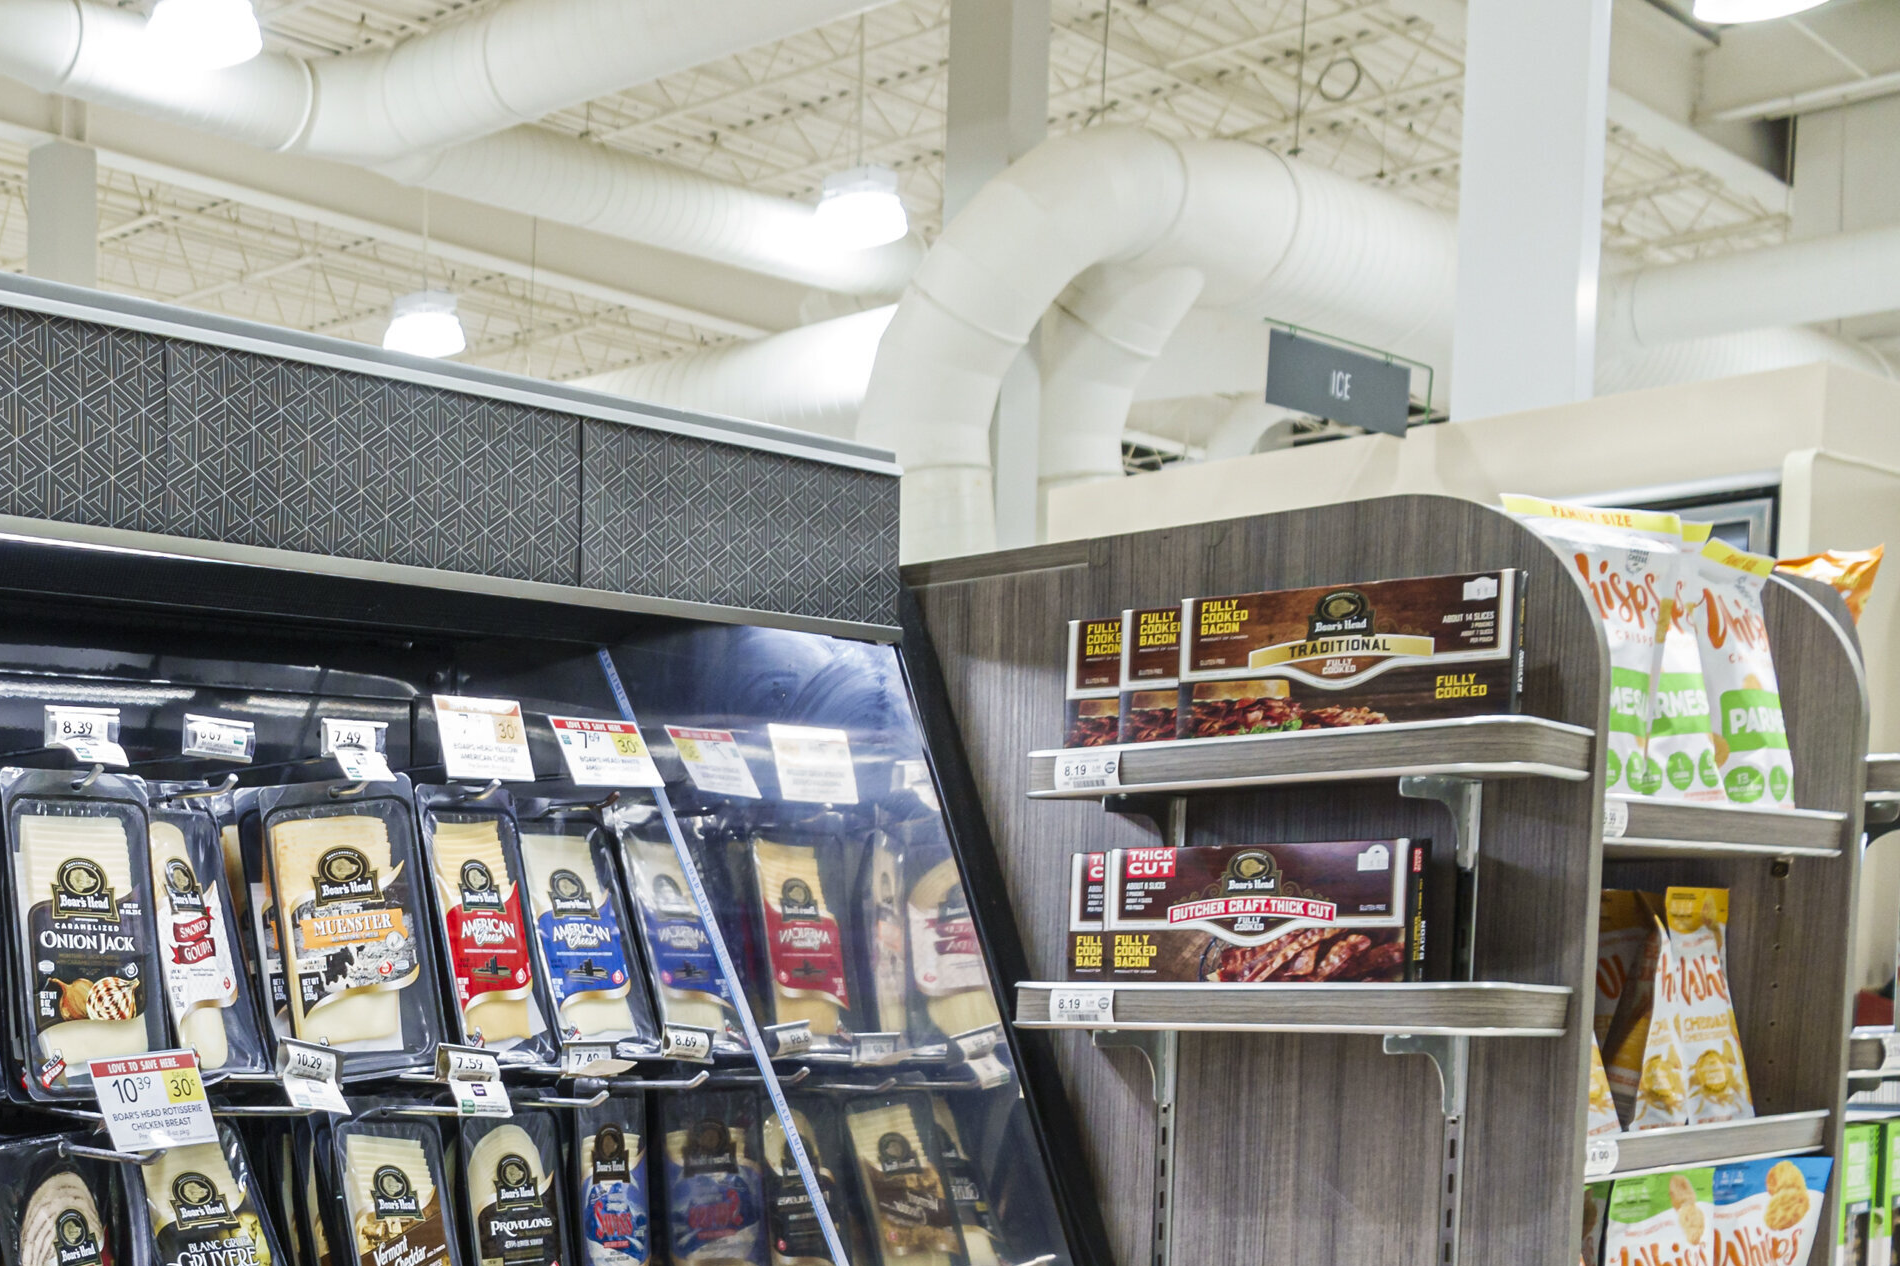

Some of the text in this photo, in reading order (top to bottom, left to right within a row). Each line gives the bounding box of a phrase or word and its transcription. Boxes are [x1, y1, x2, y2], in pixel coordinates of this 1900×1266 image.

[1331, 370, 1352, 400] ICE
[1602, 514, 1632, 528] SIZE
[1289, 638, 1391, 658] TRADITIONAL
[62, 721, 93, 734] 8.39
[334, 731, 361, 743] 7.49
[1129, 850, 1173, 861] THICK
[1128, 861, 1173, 876] CUT
[1172, 898, 1333, 922] BUTCHER CRAFT THICK CUT
[54, 922, 120, 932] CARAMELIZED
[178, 917, 209, 939] SMOKED
[313, 914, 393, 936] MUENSTER
[461, 918, 516, 941] AMERICAN
[40, 932, 135, 954] ONION JACK
[183, 939, 213, 962] GOUDA
[490, 1217, 552, 1237] PROVOLONE
